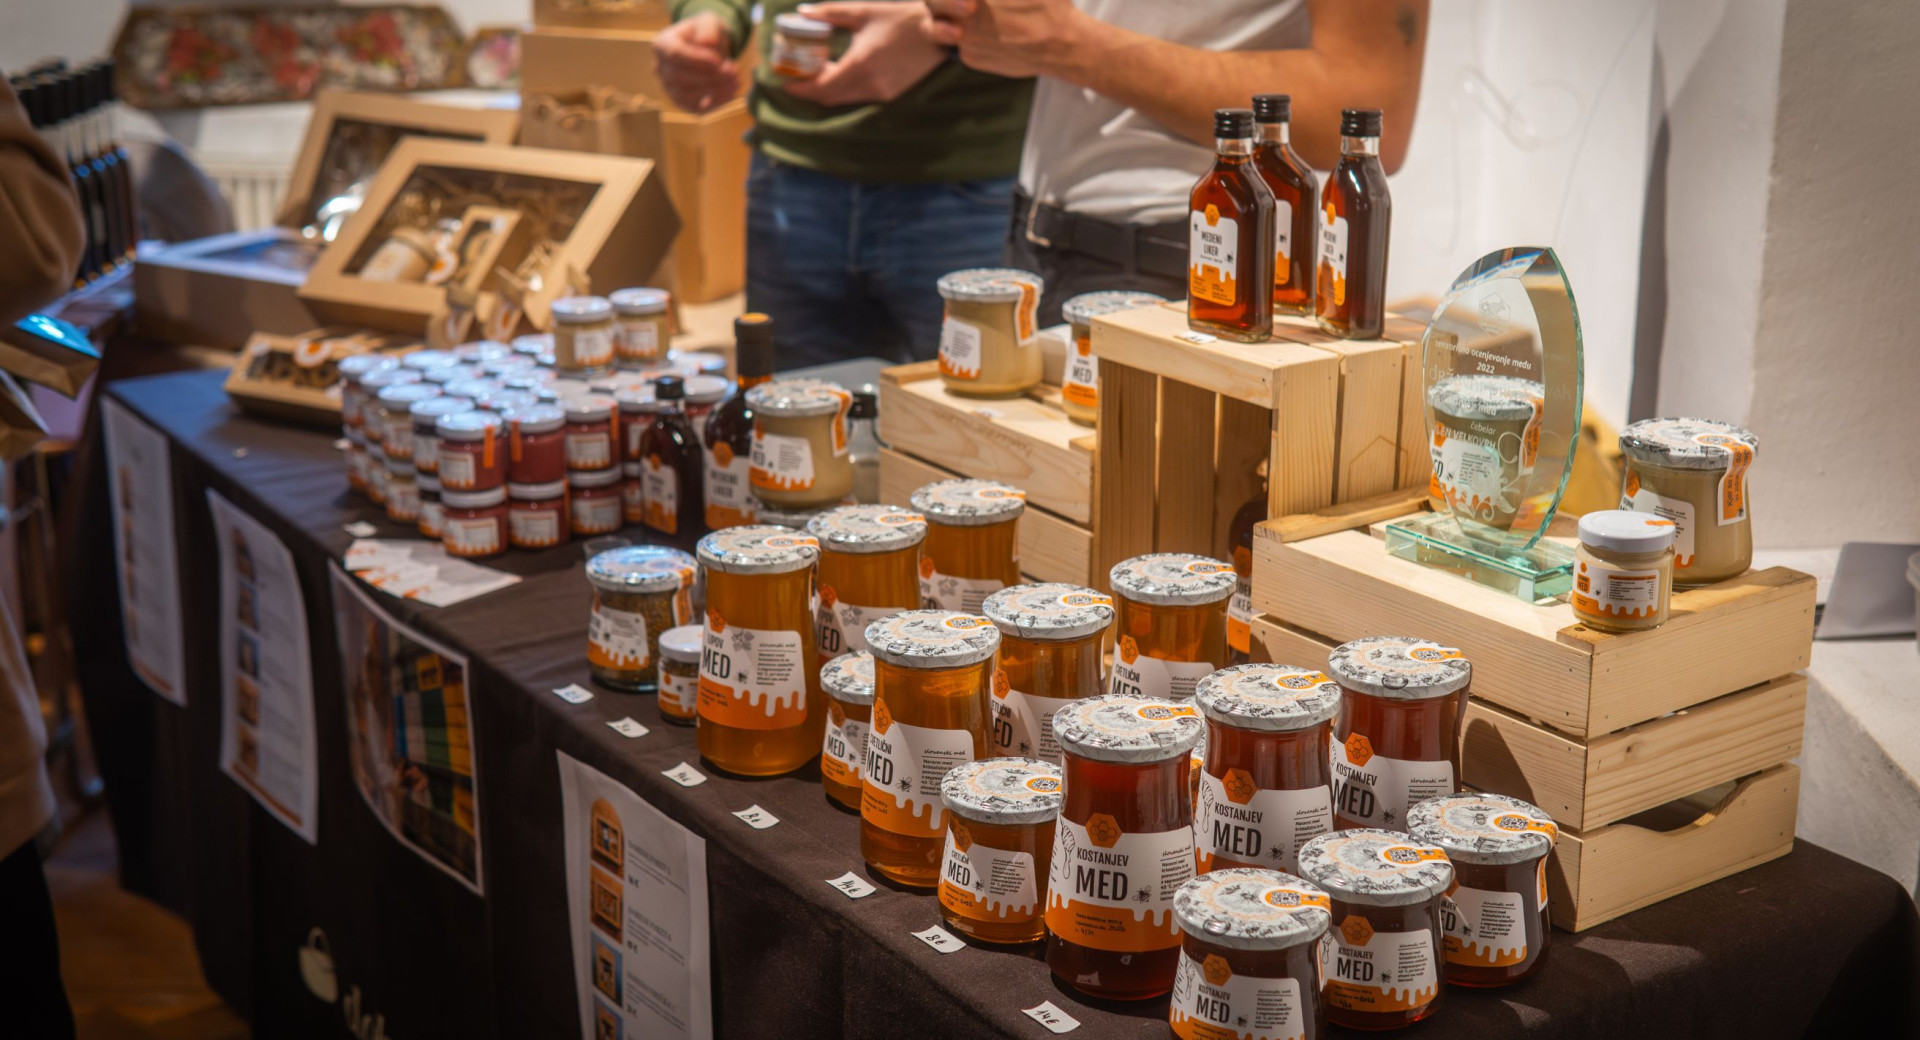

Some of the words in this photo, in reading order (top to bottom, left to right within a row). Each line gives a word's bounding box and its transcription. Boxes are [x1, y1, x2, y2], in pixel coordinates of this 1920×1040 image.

[1471, 349, 1510, 366] ocenjevanje
[1512, 358, 1532, 370] medu
[1476, 362, 1495, 374] 2022
[1454, 430, 1496, 449] VELKOVRH
[1470, 422, 1496, 435] čebelar
[702, 645, 731, 679] MED
[995, 717, 1012, 748] ED
[828, 734, 845, 758] MED
[924, 748, 952, 756] slovenski
[866, 746, 893, 785] MED
[1336, 761, 1378, 786] KOSTANJEV
[1334, 778, 1375, 819] MED
[1214, 802, 1263, 824] KOSTANJEV
[1212, 819, 1262, 857] MED
[1076, 846, 1129, 867] KOSTANJEV
[948, 860, 970, 886] MED
[1075, 864, 1128, 901] MED
[1338, 946, 1373, 959] KOSTANJEV
[1337, 957, 1373, 982] MED
[1198, 984, 1231, 1000] KOSTANJEV
[1034, 1010, 1060, 1025] 14€
[1196, 994, 1230, 1023] MED
